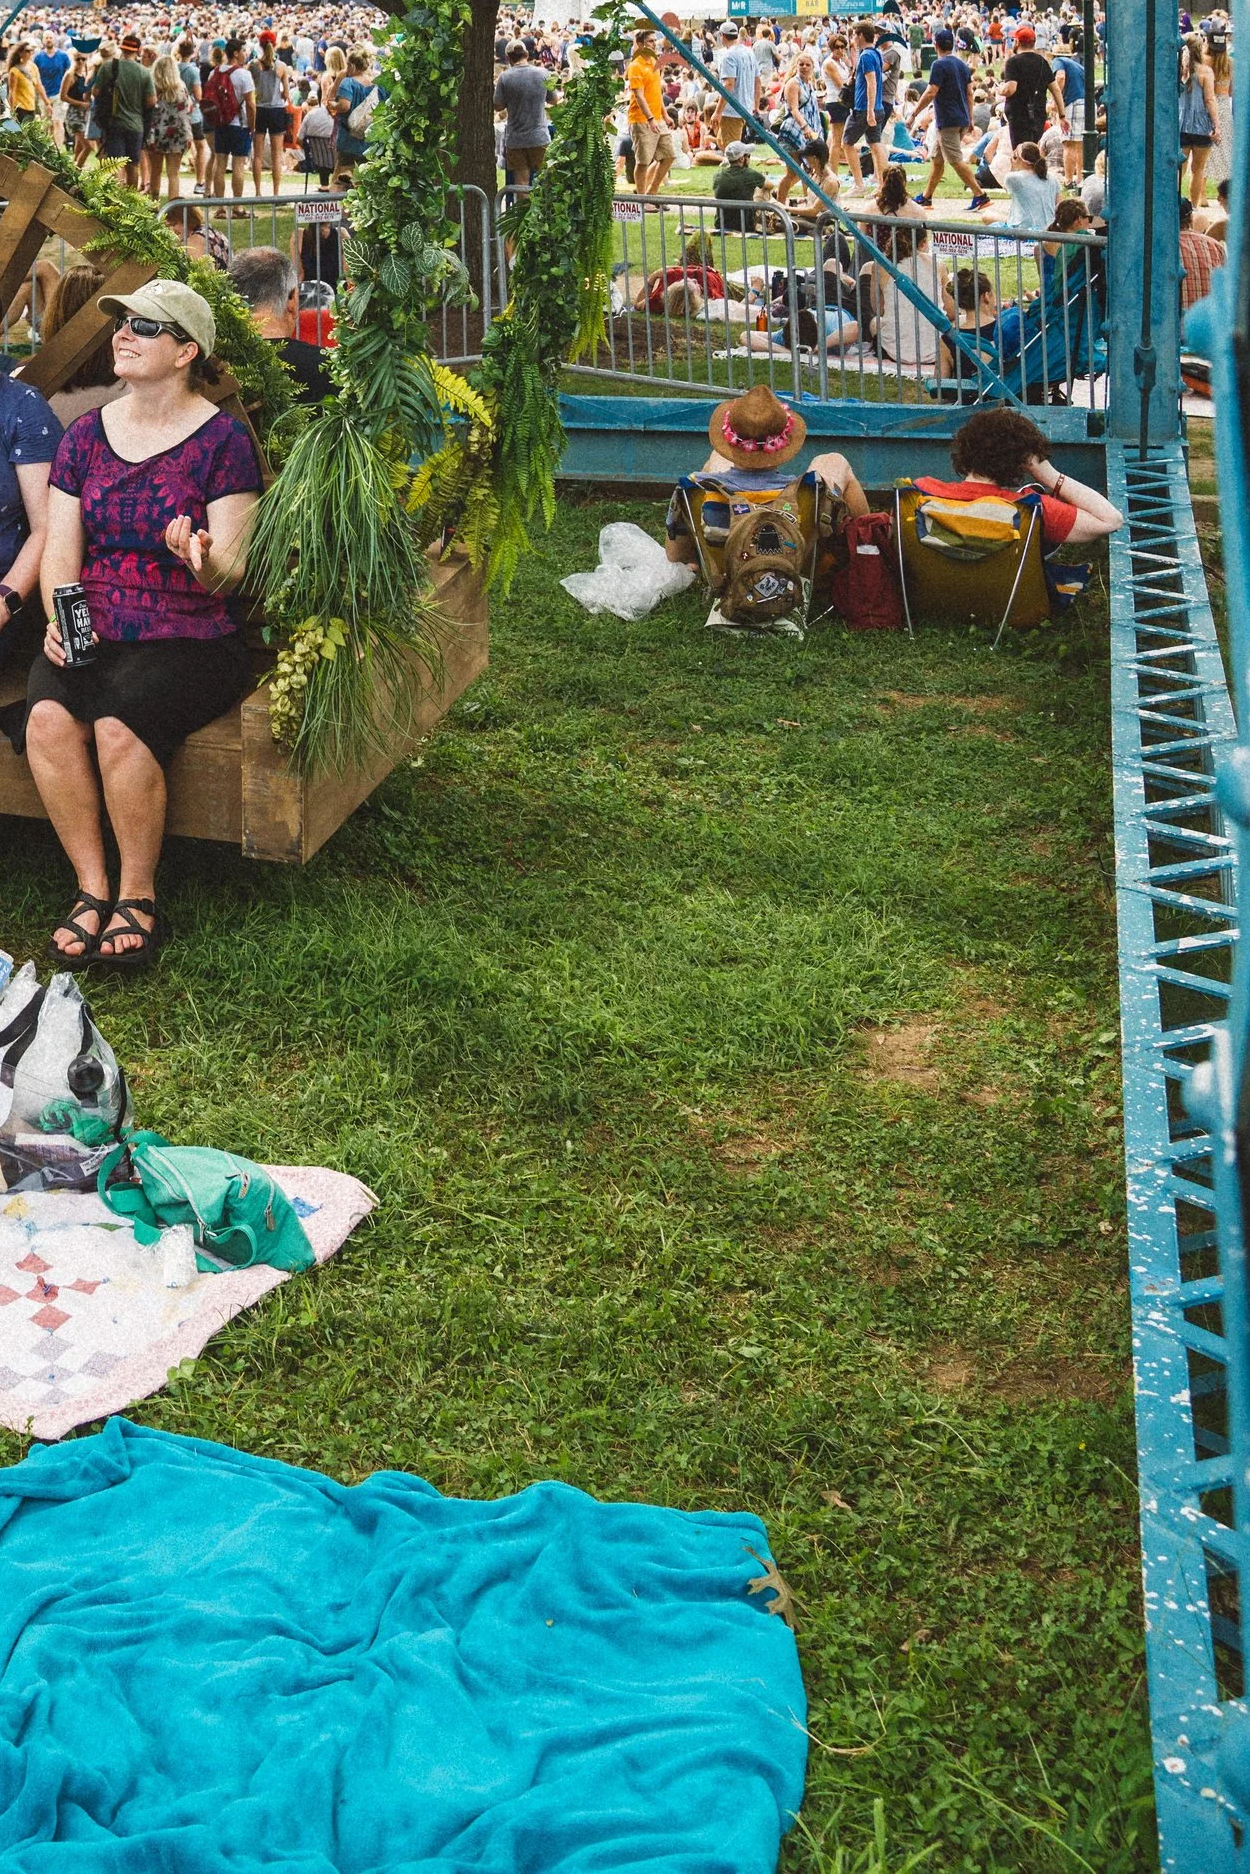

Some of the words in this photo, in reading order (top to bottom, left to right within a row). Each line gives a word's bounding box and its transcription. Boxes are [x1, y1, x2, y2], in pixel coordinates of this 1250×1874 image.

[298, 203, 340, 214] NATIONAL
[613, 202, 640, 213] TIONAL
[933, 232, 973, 247] NATIONAL
